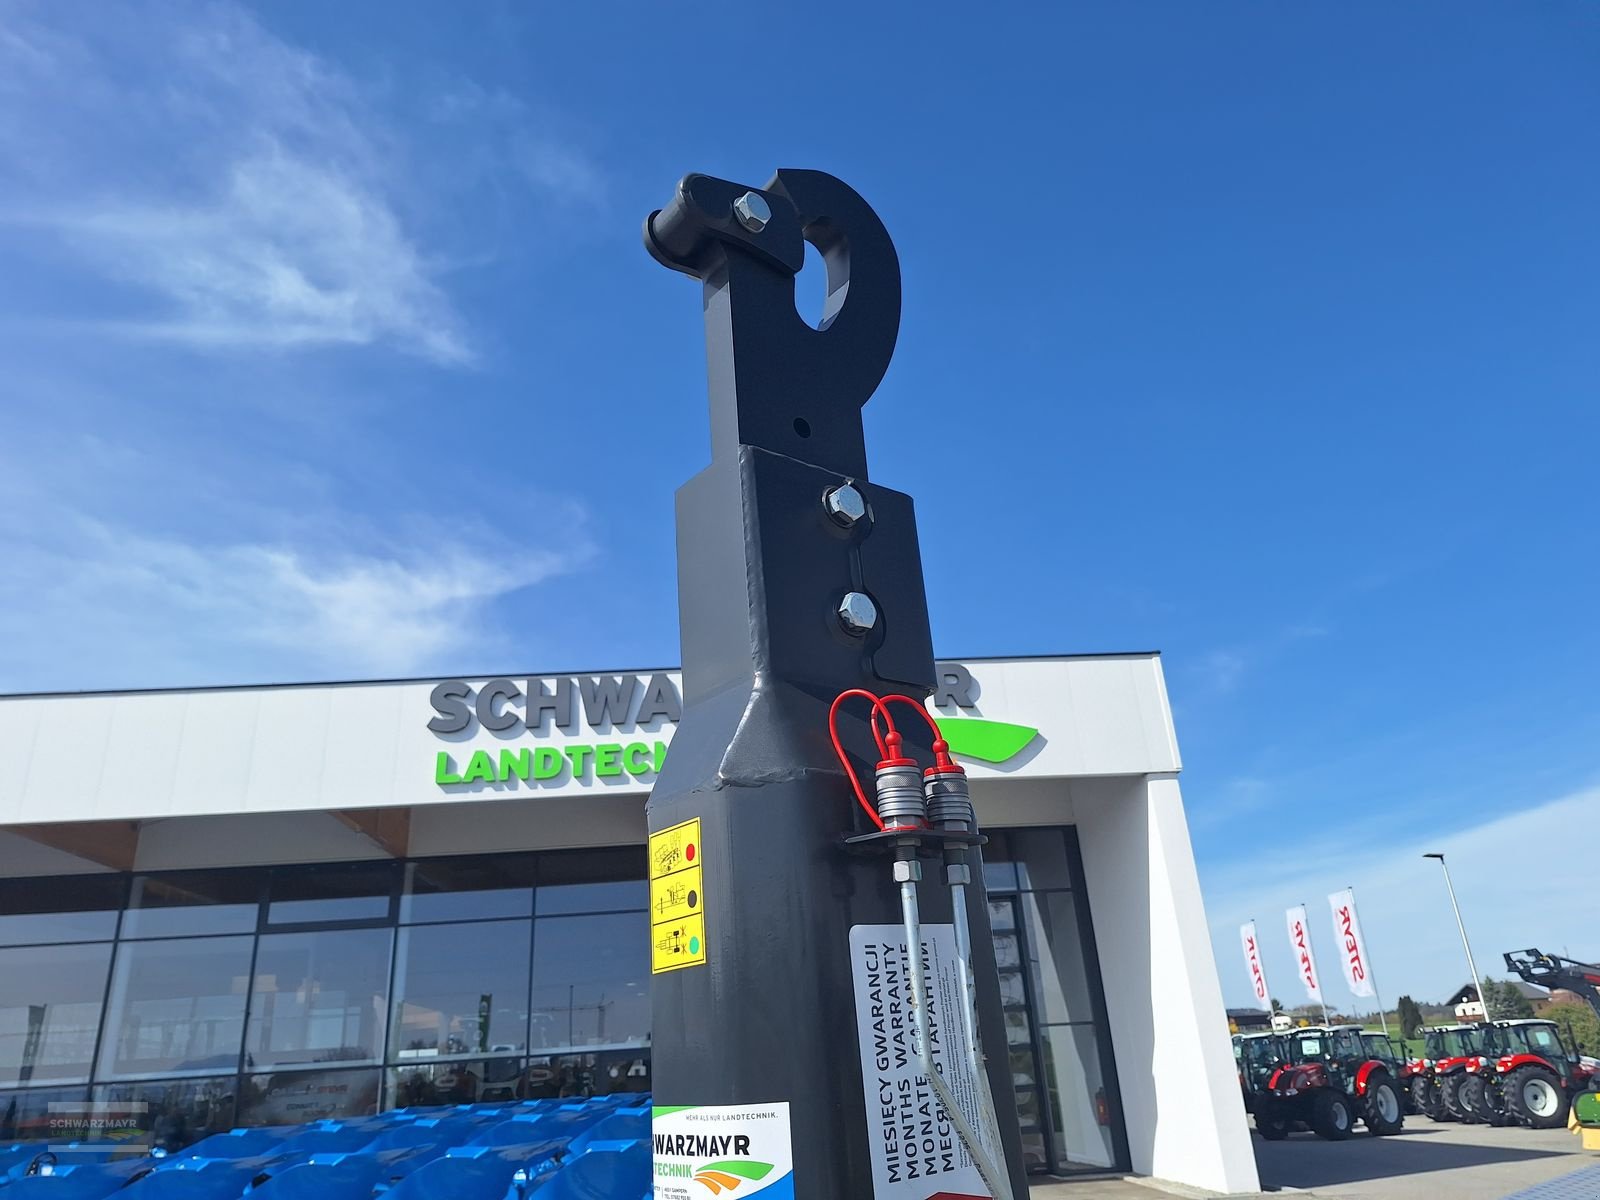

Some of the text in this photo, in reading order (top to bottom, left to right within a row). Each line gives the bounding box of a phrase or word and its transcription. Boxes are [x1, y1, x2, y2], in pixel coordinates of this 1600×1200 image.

[864, 944, 901, 1183] MIESIĘCY GWARANCJI
[882, 943, 920, 1179] MONTHS WARRANTY
[915, 1075, 937, 1175] MONATE
[653, 1134, 750, 1157] WARZMAYR
